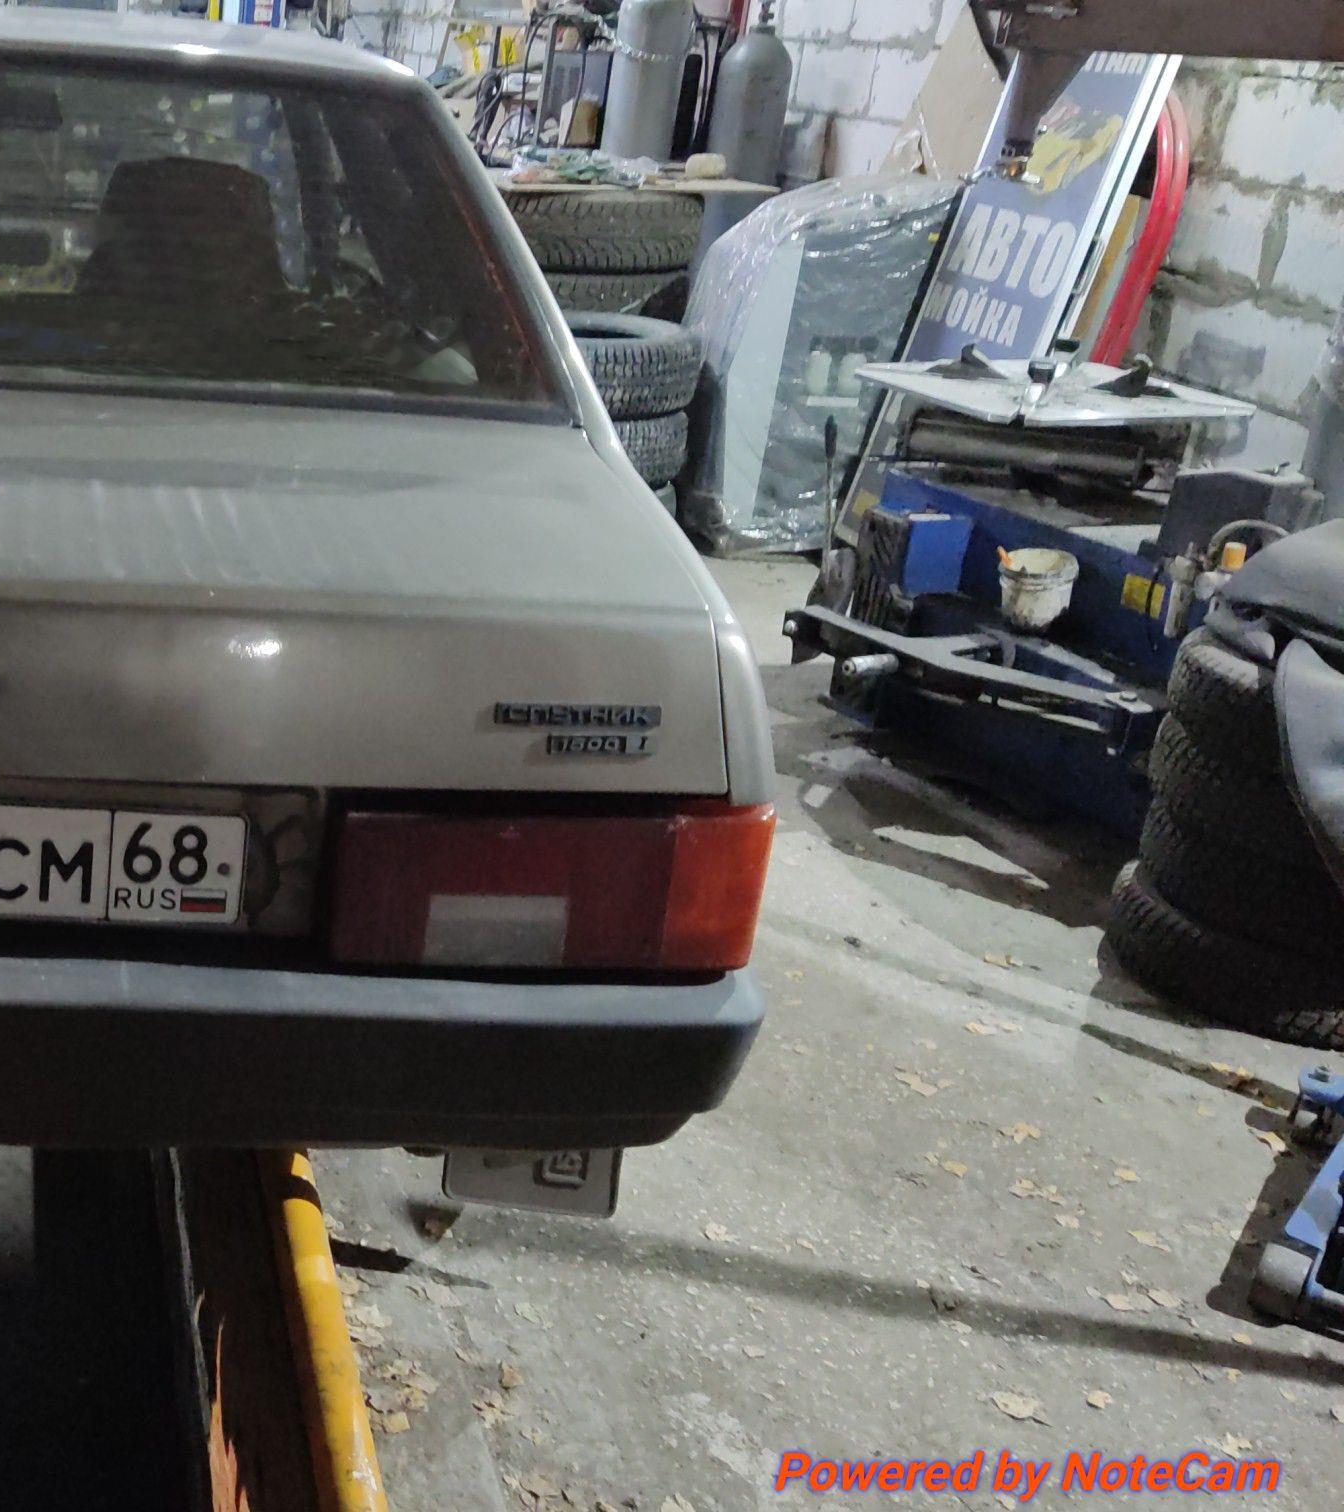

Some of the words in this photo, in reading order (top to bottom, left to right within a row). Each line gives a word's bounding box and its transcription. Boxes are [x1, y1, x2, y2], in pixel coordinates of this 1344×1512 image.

[948, 203, 1077, 298] АВТО
[923, 280, 1023, 347] МОЙКА
[122, 821, 209, 886] 68
[113, 887, 177, 911] RUS
